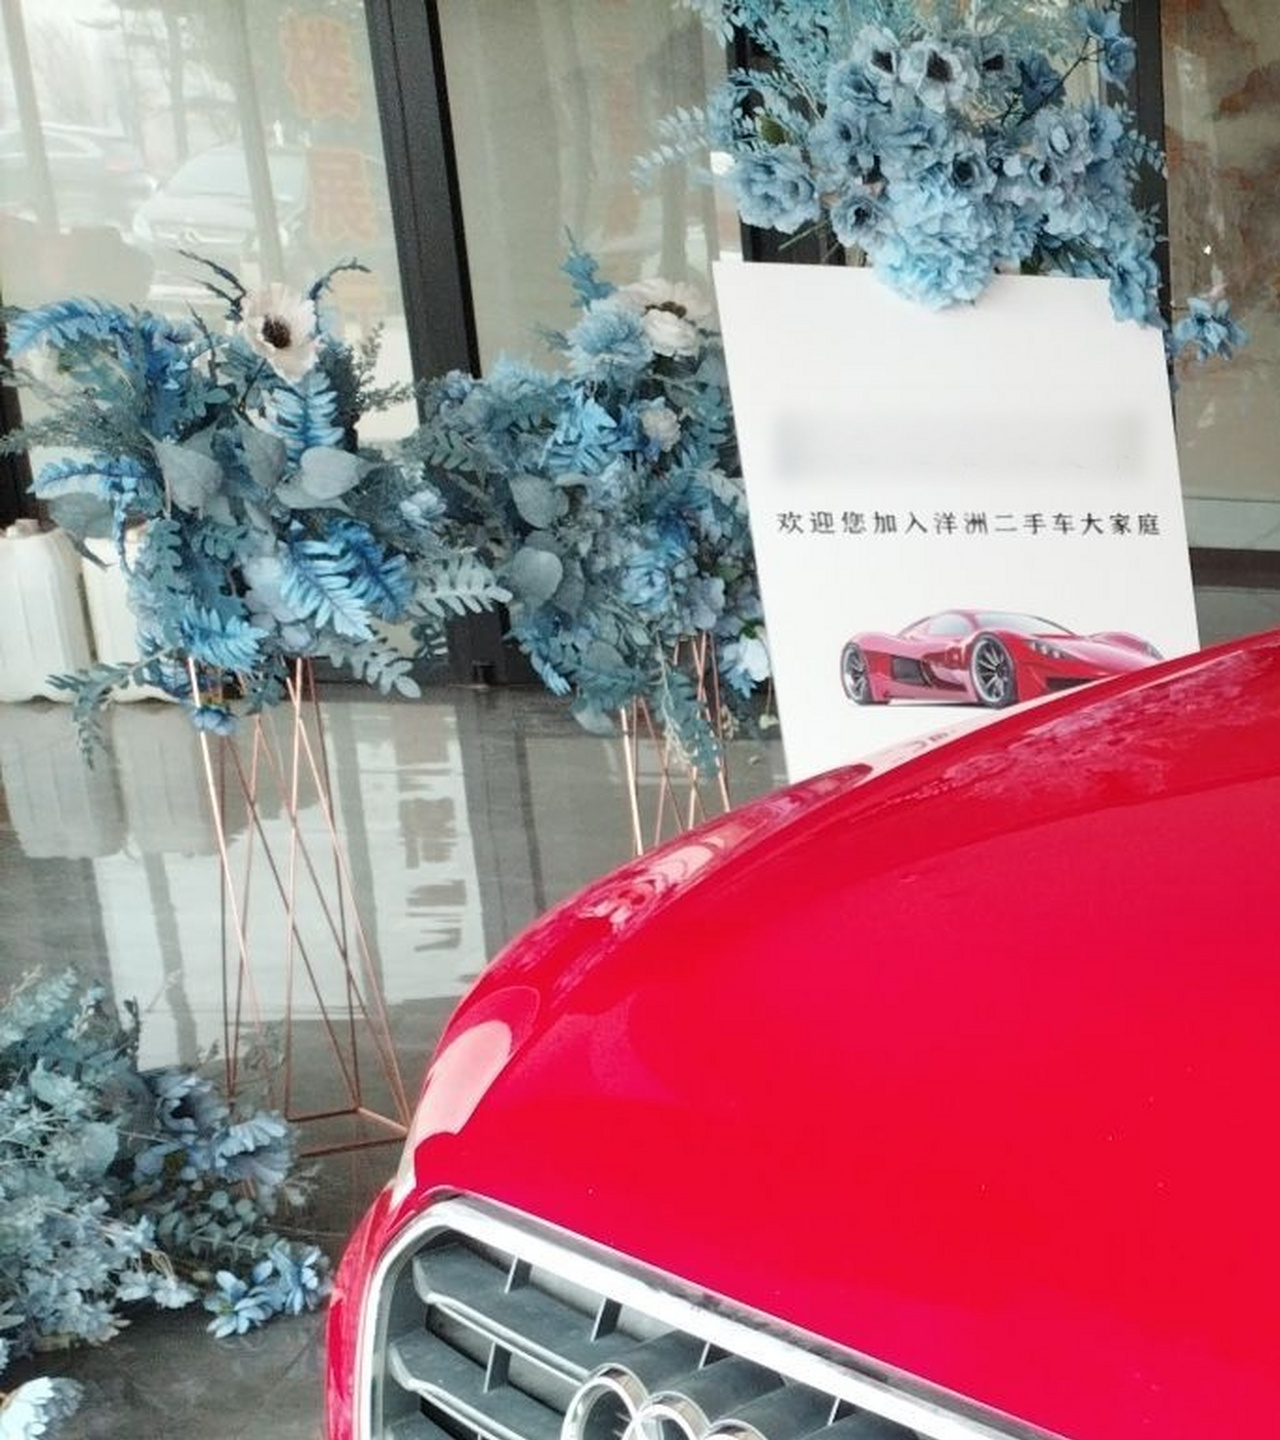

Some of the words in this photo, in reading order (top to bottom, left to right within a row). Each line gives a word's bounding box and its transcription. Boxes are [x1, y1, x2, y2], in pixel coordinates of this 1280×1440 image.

[777, 510, 1161, 536] 欢迎您加入洋洲二手车大家庭
